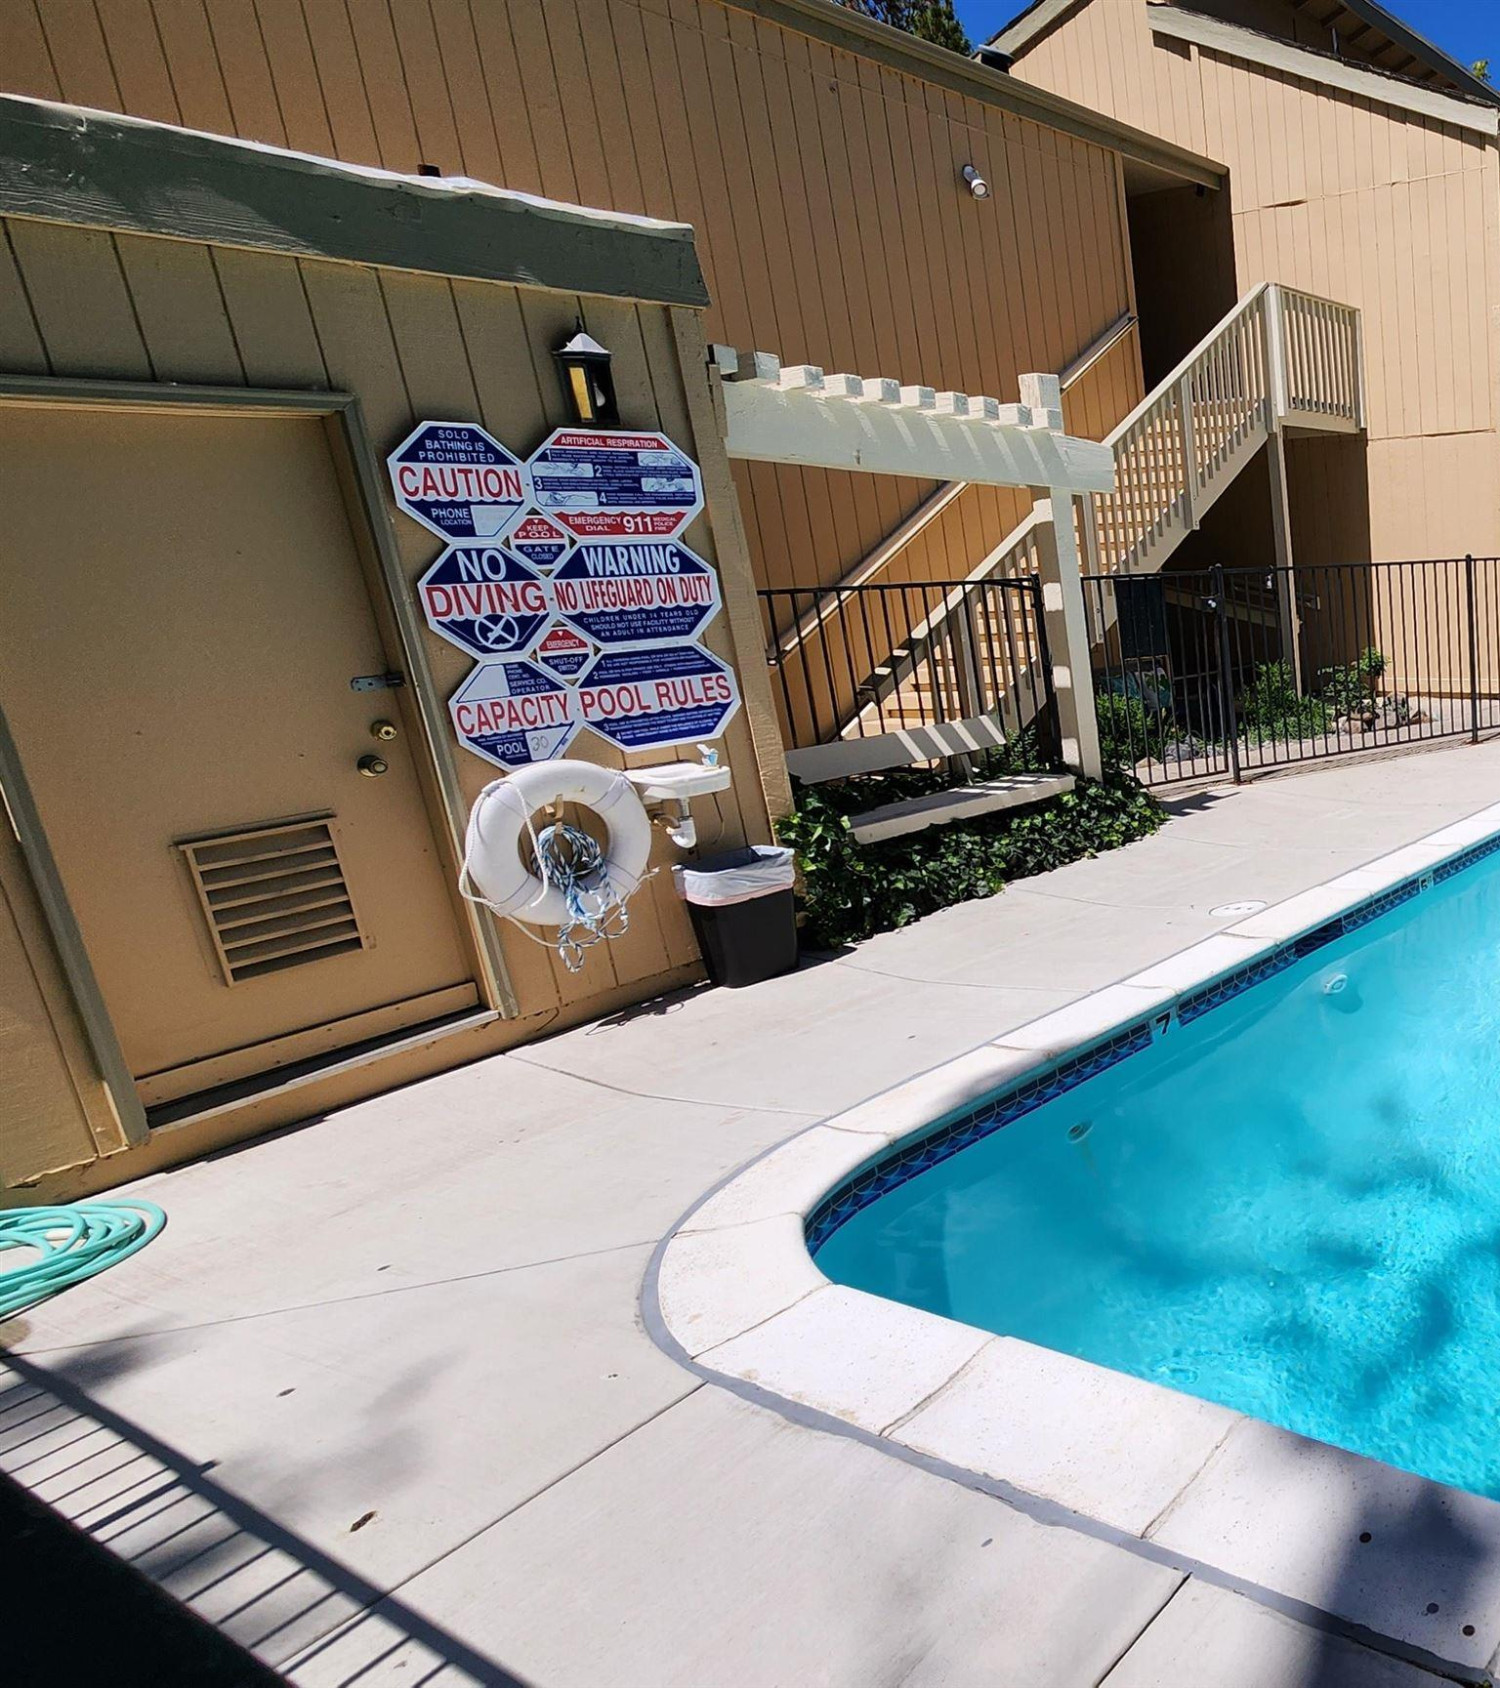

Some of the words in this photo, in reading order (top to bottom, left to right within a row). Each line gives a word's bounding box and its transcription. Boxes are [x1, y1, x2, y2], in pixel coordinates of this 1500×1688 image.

[438, 430, 468, 439] SOLO
[425, 440, 472, 451] BATHING
[475, 442, 485, 451] IS
[560, 436, 604, 446] ARTIFICIAL
[606, 438, 658, 448] RESPIRATION
[419, 451, 495, 462] PROHIBITED
[545, 449, 551, 460] 1
[594, 465, 603, 477] 2
[399, 466, 523, 498] CAUTION
[534, 477, 543, 489] 3
[600, 492, 607, 504] 4
[431, 508, 470, 518] PHONE
[568, 516, 621, 525] EMERGENCY
[623, 516, 653, 532] 911
[526, 524, 549, 532] KEEP
[523, 545, 559, 553] GATE
[456, 549, 506, 582] NO
[581, 545, 681, 576] WARNING
[425, 581, 547, 617] DIVING
[553, 581, 578, 611] NO
[579, 577, 654, 609] LIFEGUARD
[656, 576, 678, 605] ON
[678, 575, 712, 603] DUTY
[583, 615, 620, 624] CHILDREN
[622, 613, 647, 621] UNDER
[660, 610, 683, 618] YEARS
[591, 623, 617, 631] SHOULD
[617, 621, 632, 629] NOT
[630, 620, 643, 628] USE
[642, 618, 670, 627] FACILITY
[669, 616, 695, 624] WITHOUT
[646, 624, 689, 634] ATTENDANCE
[546, 639, 580, 649] EMERGENCY
[549, 656, 583, 665] SHUT-OFF
[558, 664, 578, 672] SWITCH
[510, 679, 535, 687] SERVICE
[511, 685, 550, 694] OPERATOR
[579, 684, 652, 718] POOL
[654, 674, 732, 708] RULES
[457, 693, 568, 735] CAPACITY
[497, 742, 527, 756] POOL
[530, 735, 550, 752] 30
[1155, 1012, 1172, 1035] 7
